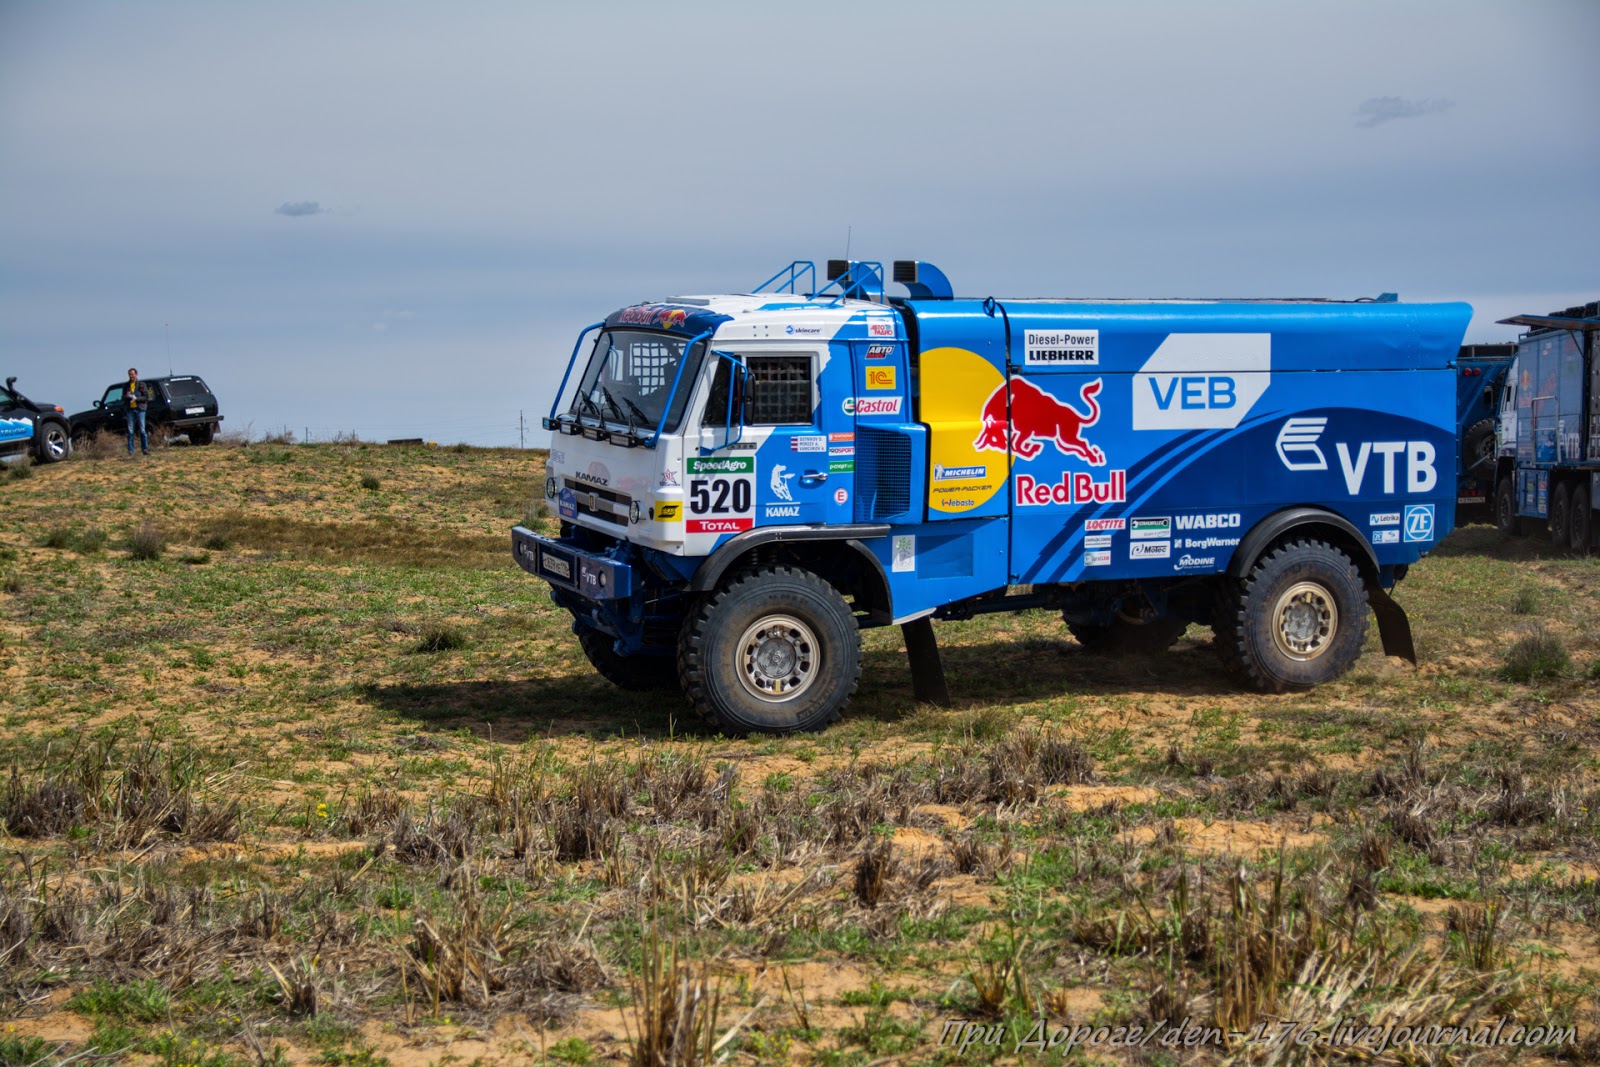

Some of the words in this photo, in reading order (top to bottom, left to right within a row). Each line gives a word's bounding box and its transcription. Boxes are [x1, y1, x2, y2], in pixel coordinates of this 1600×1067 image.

[1028, 333, 1095, 345] Diesel-Power
[1029, 350, 1095, 361] LIEBHERR
[1148, 376, 1237, 411] VEB
[856, 398, 898, 413] Castrol
[693, 460, 747, 472] SpeedAgro
[944, 468, 985, 476] MICHELIN
[1335, 441, 1438, 495] VTB
[575, 471, 608, 487] KAMAZ
[1016, 471, 1071, 505] Red
[1074, 470, 1126, 503] Bull
[690, 478, 751, 514] 520
[765, 506, 800, 518] KAMAZ
[699, 520, 741, 531] TOTAL
[1086, 519, 1124, 530] LOCTITE
[1175, 513, 1241, 530] WABCO
[1409, 513, 1430, 533] ZF
[1185, 537, 1240, 549] BorgWarner
[1179, 557, 1215, 566] MODINE
[586, 572, 597, 585] VTB
